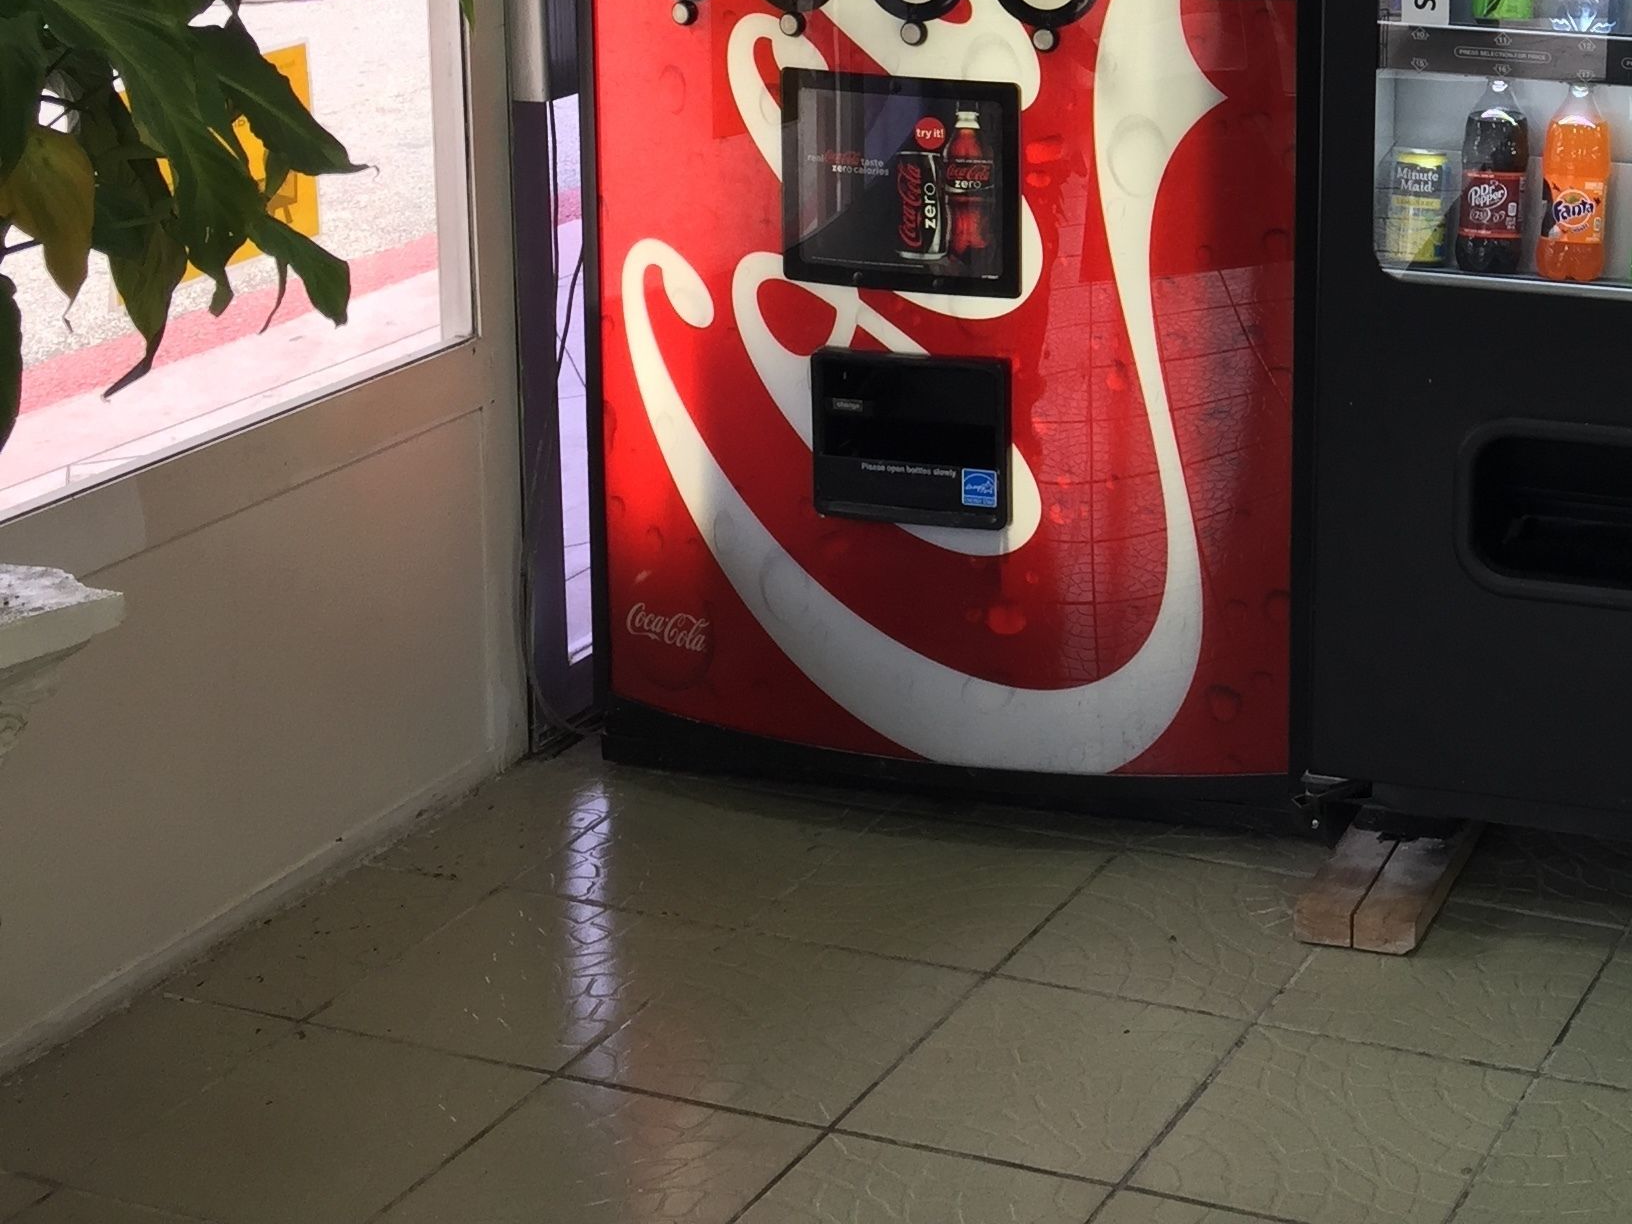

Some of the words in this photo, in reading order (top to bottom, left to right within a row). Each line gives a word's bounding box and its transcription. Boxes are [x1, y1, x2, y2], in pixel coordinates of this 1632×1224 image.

[1459, 48, 1478, 56] PRESS
[1480, 49, 1513, 58] SELECTION
[916, 129, 932, 138] try
[934, 128, 944, 138] it!
[832, 164, 852, 174] zero
[854, 166, 889, 175] calories
[1397, 167, 1439, 181] Minute
[955, 180, 981, 189] zero
[1401, 179, 1432, 192] Maid
[1481, 184, 1495, 195] Dr
[1470, 187, 1504, 206] Pepper
[924, 182, 937, 229] zero
[1553, 199, 1594, 222] Fanta
[933, 469, 956, 478] slowly
[626, 602, 710, 651] Coca-Cola
